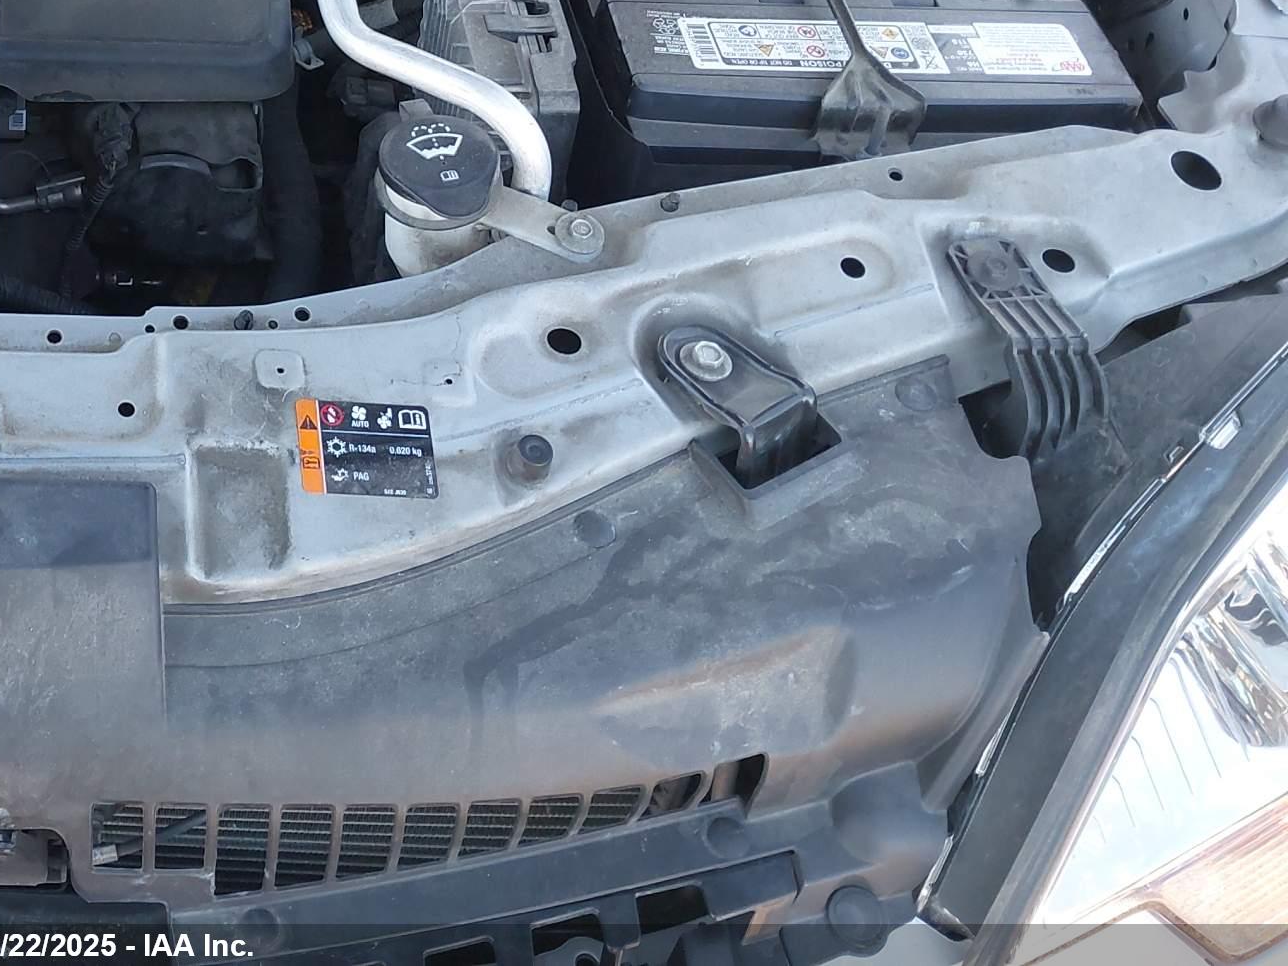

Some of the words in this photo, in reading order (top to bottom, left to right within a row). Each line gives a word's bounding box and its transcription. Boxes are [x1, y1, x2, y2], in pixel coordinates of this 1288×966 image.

[352, 420, 369, 428] AUTO
[349, 443, 376, 454] R-134a
[412, 447, 422, 457] kg
[353, 471, 370, 481] PAG
